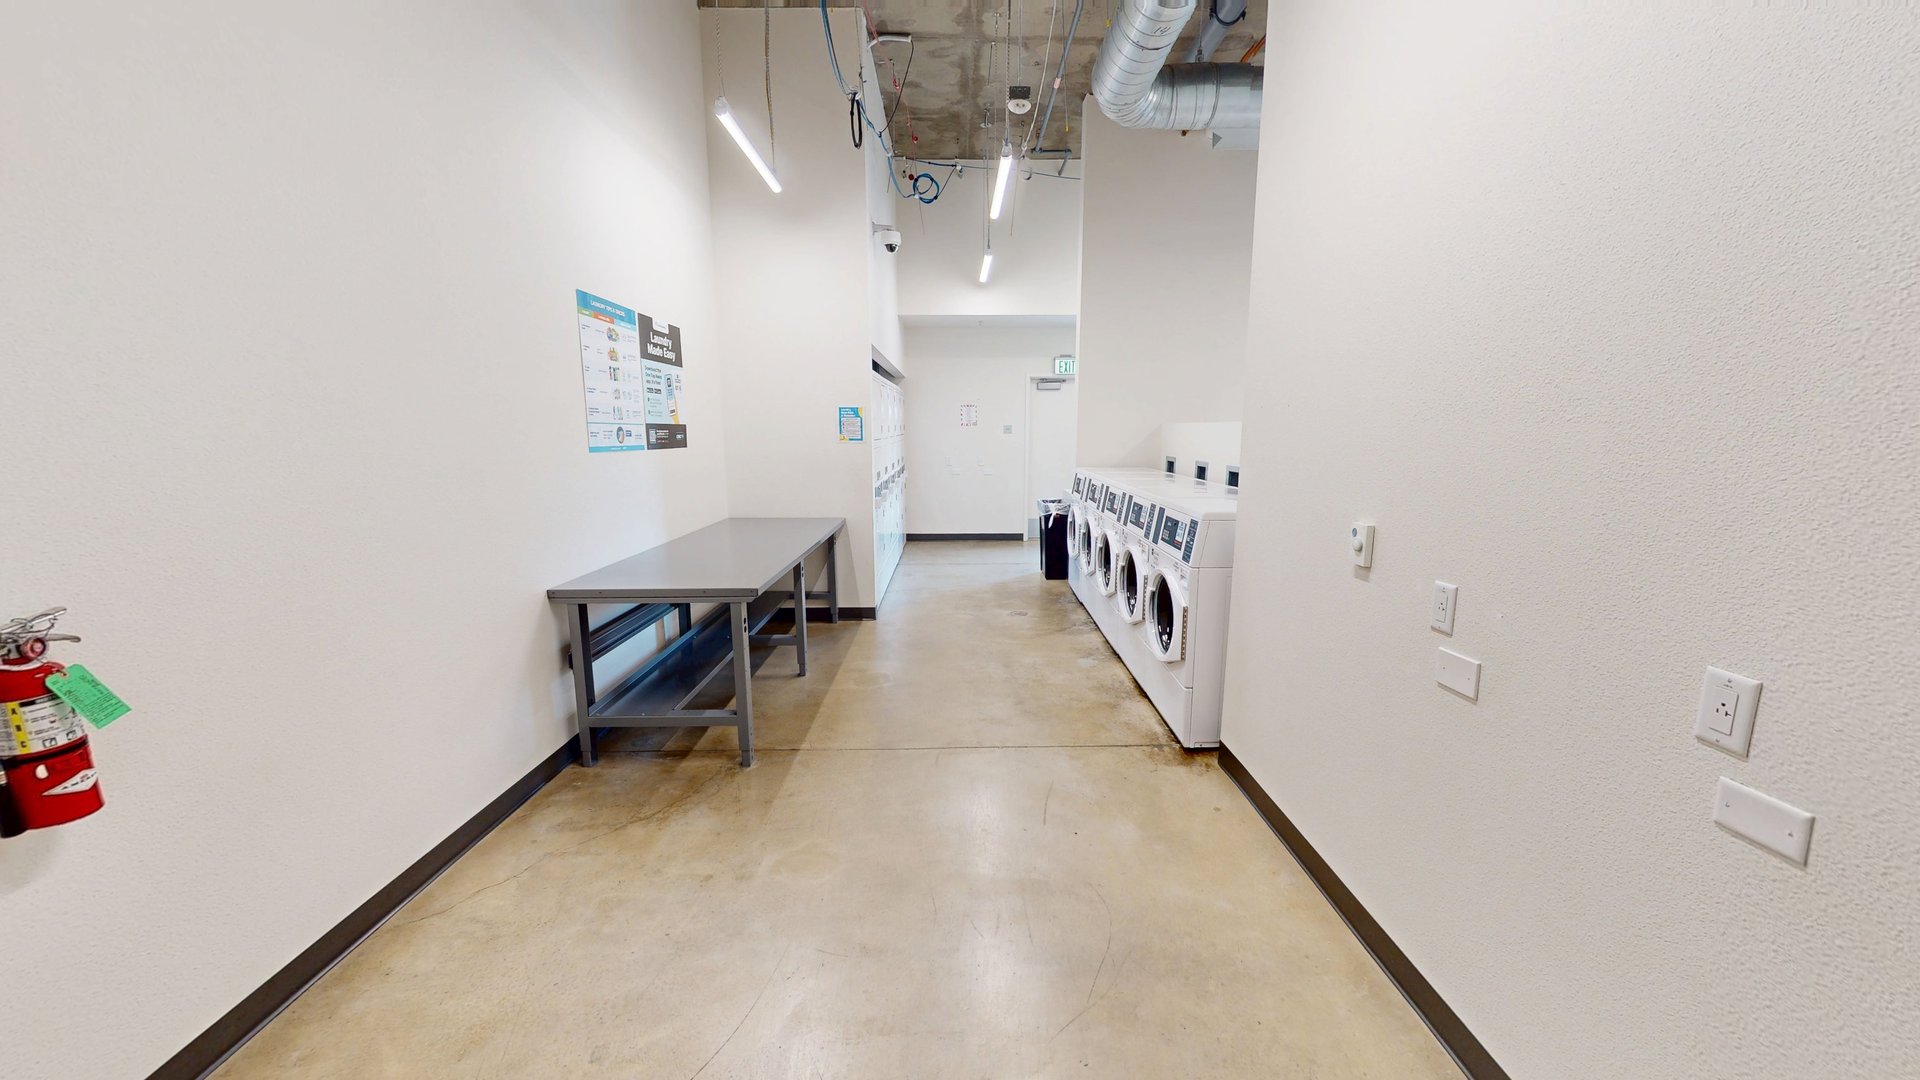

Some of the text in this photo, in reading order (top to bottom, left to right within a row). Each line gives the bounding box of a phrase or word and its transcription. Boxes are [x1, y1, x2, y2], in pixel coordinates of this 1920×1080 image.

[1153, 26, 1171, 35] 14
[650, 331, 672, 350] Laundry
[647, 342, 676, 362] Made Easy
[1059, 360, 1075, 373] EXIT
